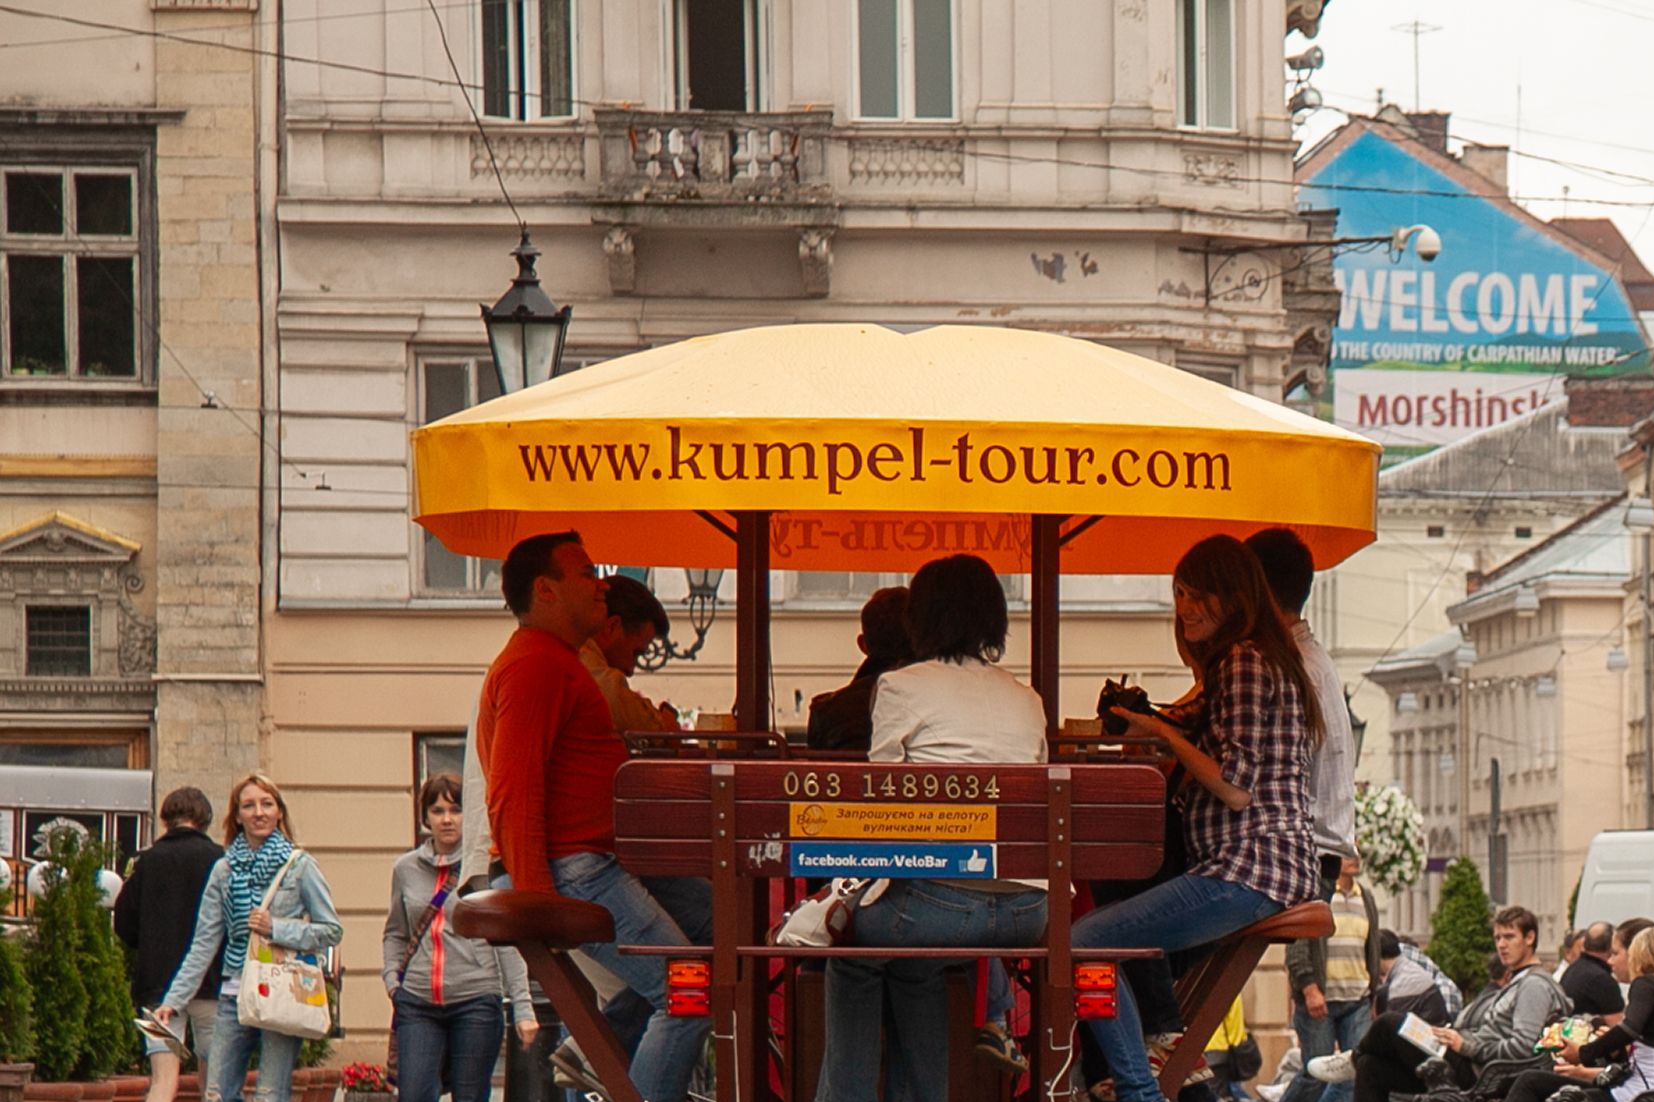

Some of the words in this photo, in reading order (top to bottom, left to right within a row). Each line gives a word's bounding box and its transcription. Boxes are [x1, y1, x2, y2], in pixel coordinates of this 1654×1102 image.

[1333, 268, 1599, 335] WELCOME
[1343, 342, 1369, 360] THE
[1372, 343, 1442, 362] COUNTRY
[1444, 344, 1463, 362] OF
[1467, 344, 1562, 364] CARPATHIAN
[519, 426, 1232, 494] www.kumpel-tour.com
[783, 771, 842, 797] 063
[862, 773, 1001, 799] 1489634
[836, 808, 915, 820] Запрошуємо
[919, 811, 934, 819] на
[938, 811, 989, 821] велотур
[863, 822, 931, 833] вуличками
[935, 823, 973, 833] міста!
[798, 854, 948, 869] facebook.com/VeloBar
